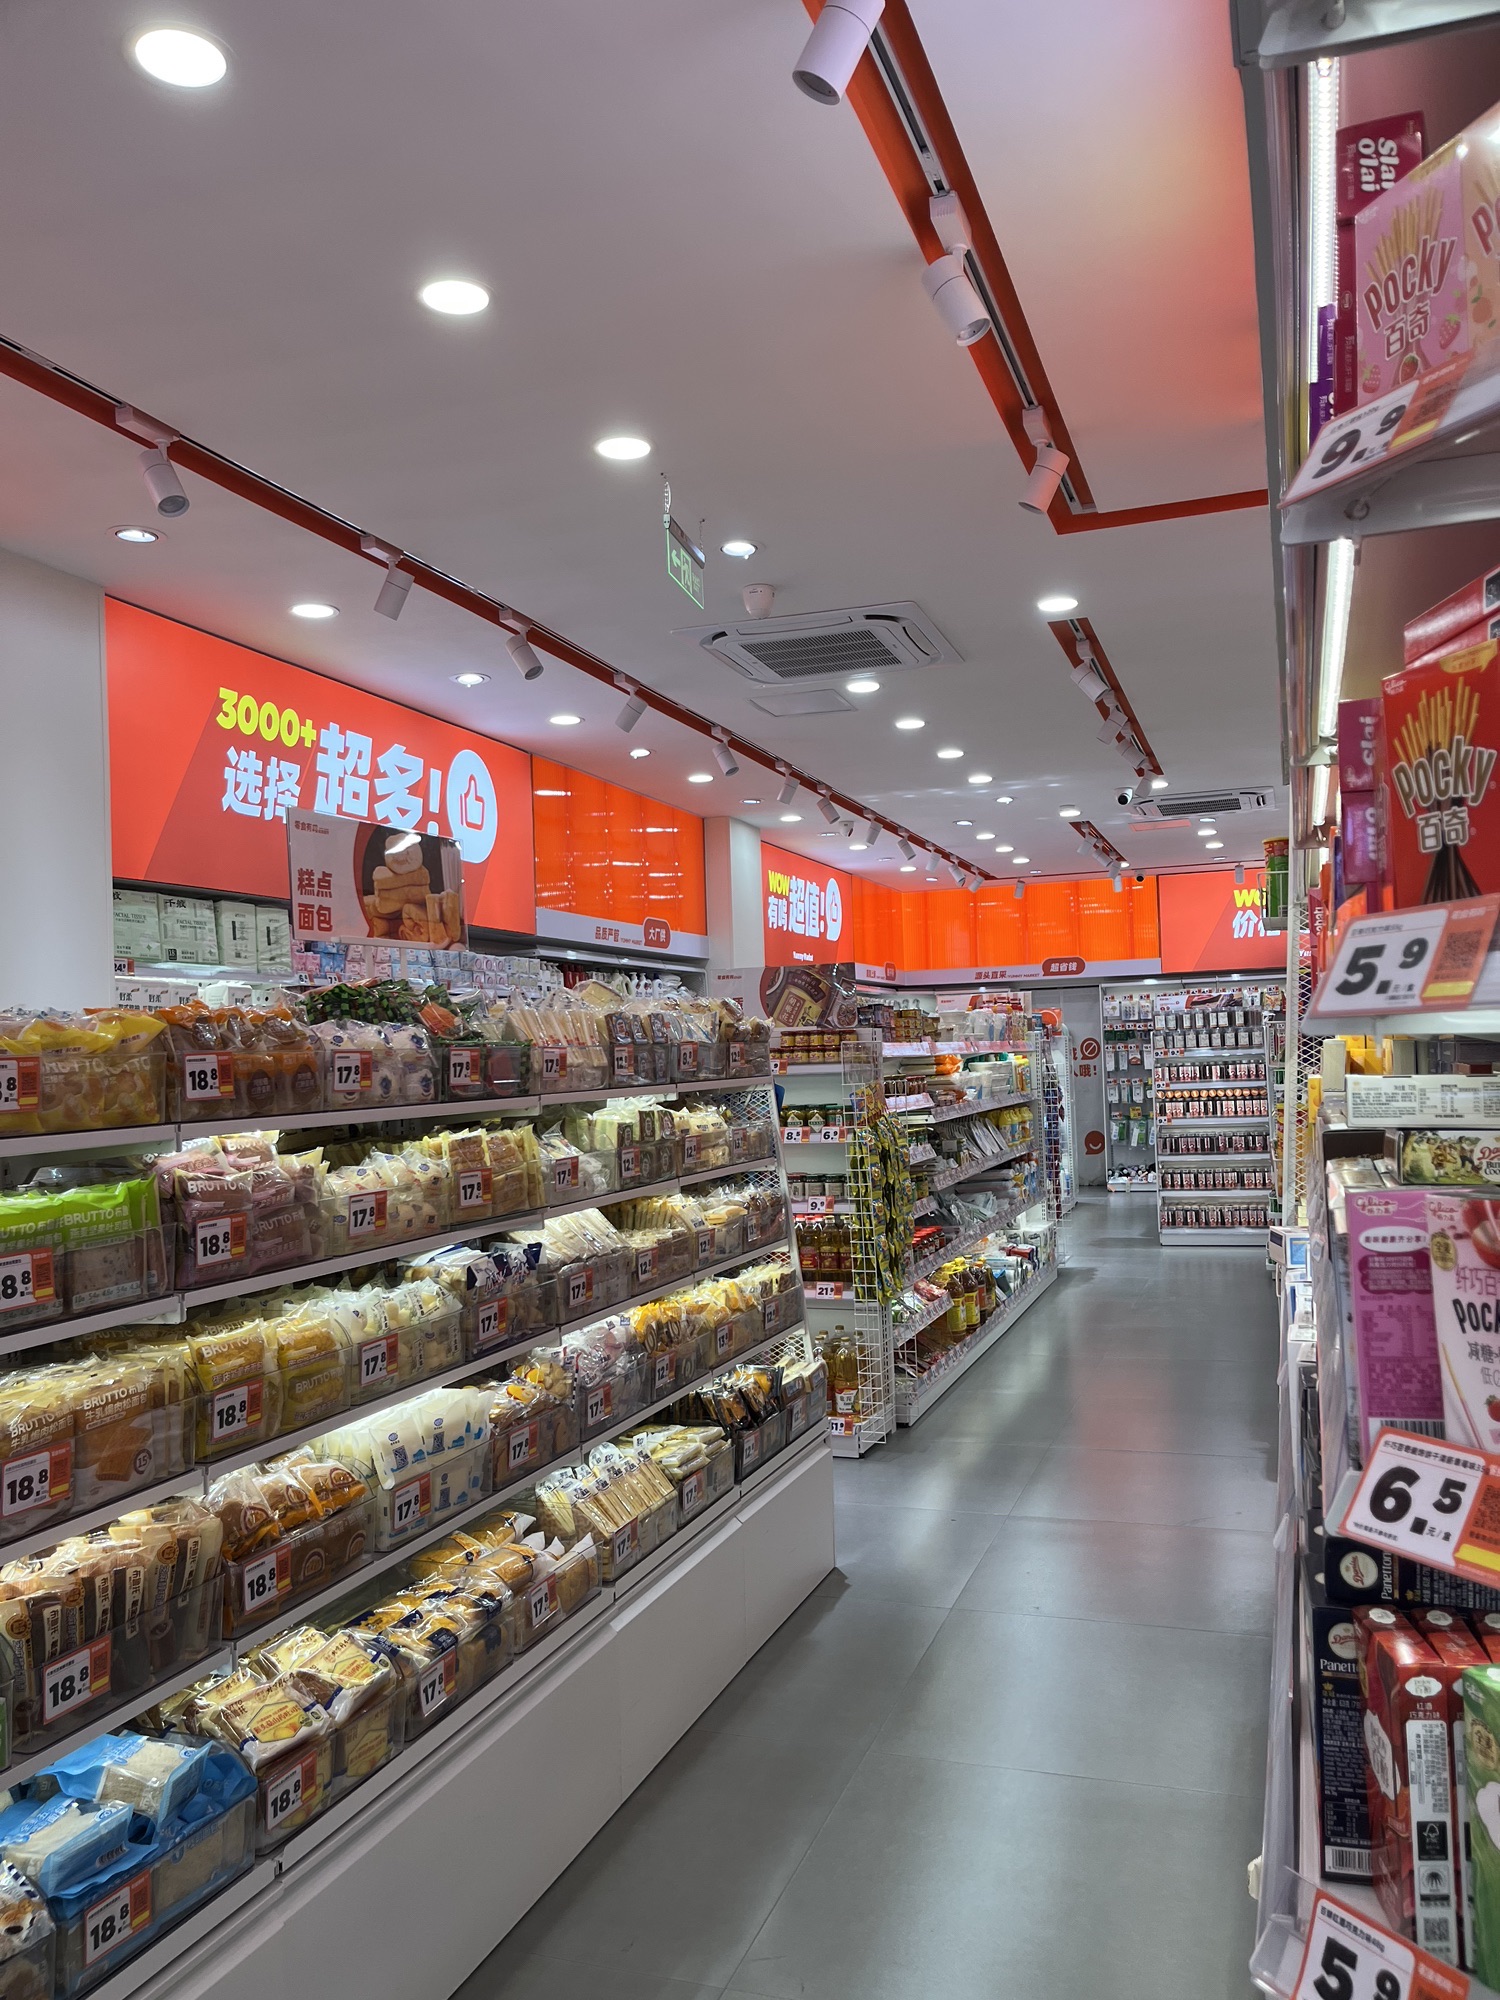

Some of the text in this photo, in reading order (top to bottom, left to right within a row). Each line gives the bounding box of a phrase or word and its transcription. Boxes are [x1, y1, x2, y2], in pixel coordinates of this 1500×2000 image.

[1362, 235, 1457, 333] POCKY
[1384, 300, 1431, 361] 百奇
[1312, 404, 1407, 480] 9.9
[216, 686, 317, 749] 3000+
[221, 745, 302, 825] 选择
[1391, 735, 1497, 819] POCKY
[1417, 806, 1470, 854] 百奇
[297, 867, 333, 898] 糕点
[768, 870, 790, 896] WOW
[297, 902, 333, 932] 面包
[974, 970, 1008, 980] 源头直采
[1049, 962, 1078, 972] 超省钱
[1335, 937, 1429, 996] 5.9
[188, 1068, 218, 1091] 18.8
[337, 1065, 360, 1084] 17.8
[452, 1061, 470, 1079] 17.8
[786, 1131, 800, 1141] 8.5
[823, 1130, 838, 1140] 6.9
[187, 1180, 237, 1194] BRUTTO
[556, 1168, 571, 1185] 17.8
[461, 1181, 482, 1201] 17.8
[64, 1207, 114, 1226] BRUTTO
[352, 1207, 375, 1228] 17.8
[810, 1201, 824, 1211] 9.9
[200, 1231, 230, 1257] 18.8
[571, 1284, 586, 1300] 17.8
[817, 1286, 834, 1296] 21.9
[1455, 1265, 1500, 1296] 纤巧百
[480, 1314, 498, 1334] 17.8
[202, 1337, 250, 1359] BRUTTO
[364, 1351, 386, 1377] 17.8
[83, 1388, 128, 1410] BRUTTO
[11, 1413, 54, 1438] BRUTTO
[216, 1400, 247, 1430] 18.8
[512, 1438, 529, 1461] 17.8
[6, 1468, 49, 1505] 18.8
[397, 1495, 419, 1522] 17.8
[1369, 1465, 1468, 1536] 6.5
[247, 1567, 276, 1602] 18.8
[533, 1592, 549, 1619] 17.8
[48, 1665, 89, 1708] 18.8
[422, 1672, 443, 1705] 17.8
[271, 1778, 301, 1819] 18.8
[90, 1902, 129, 1950] 18.8
